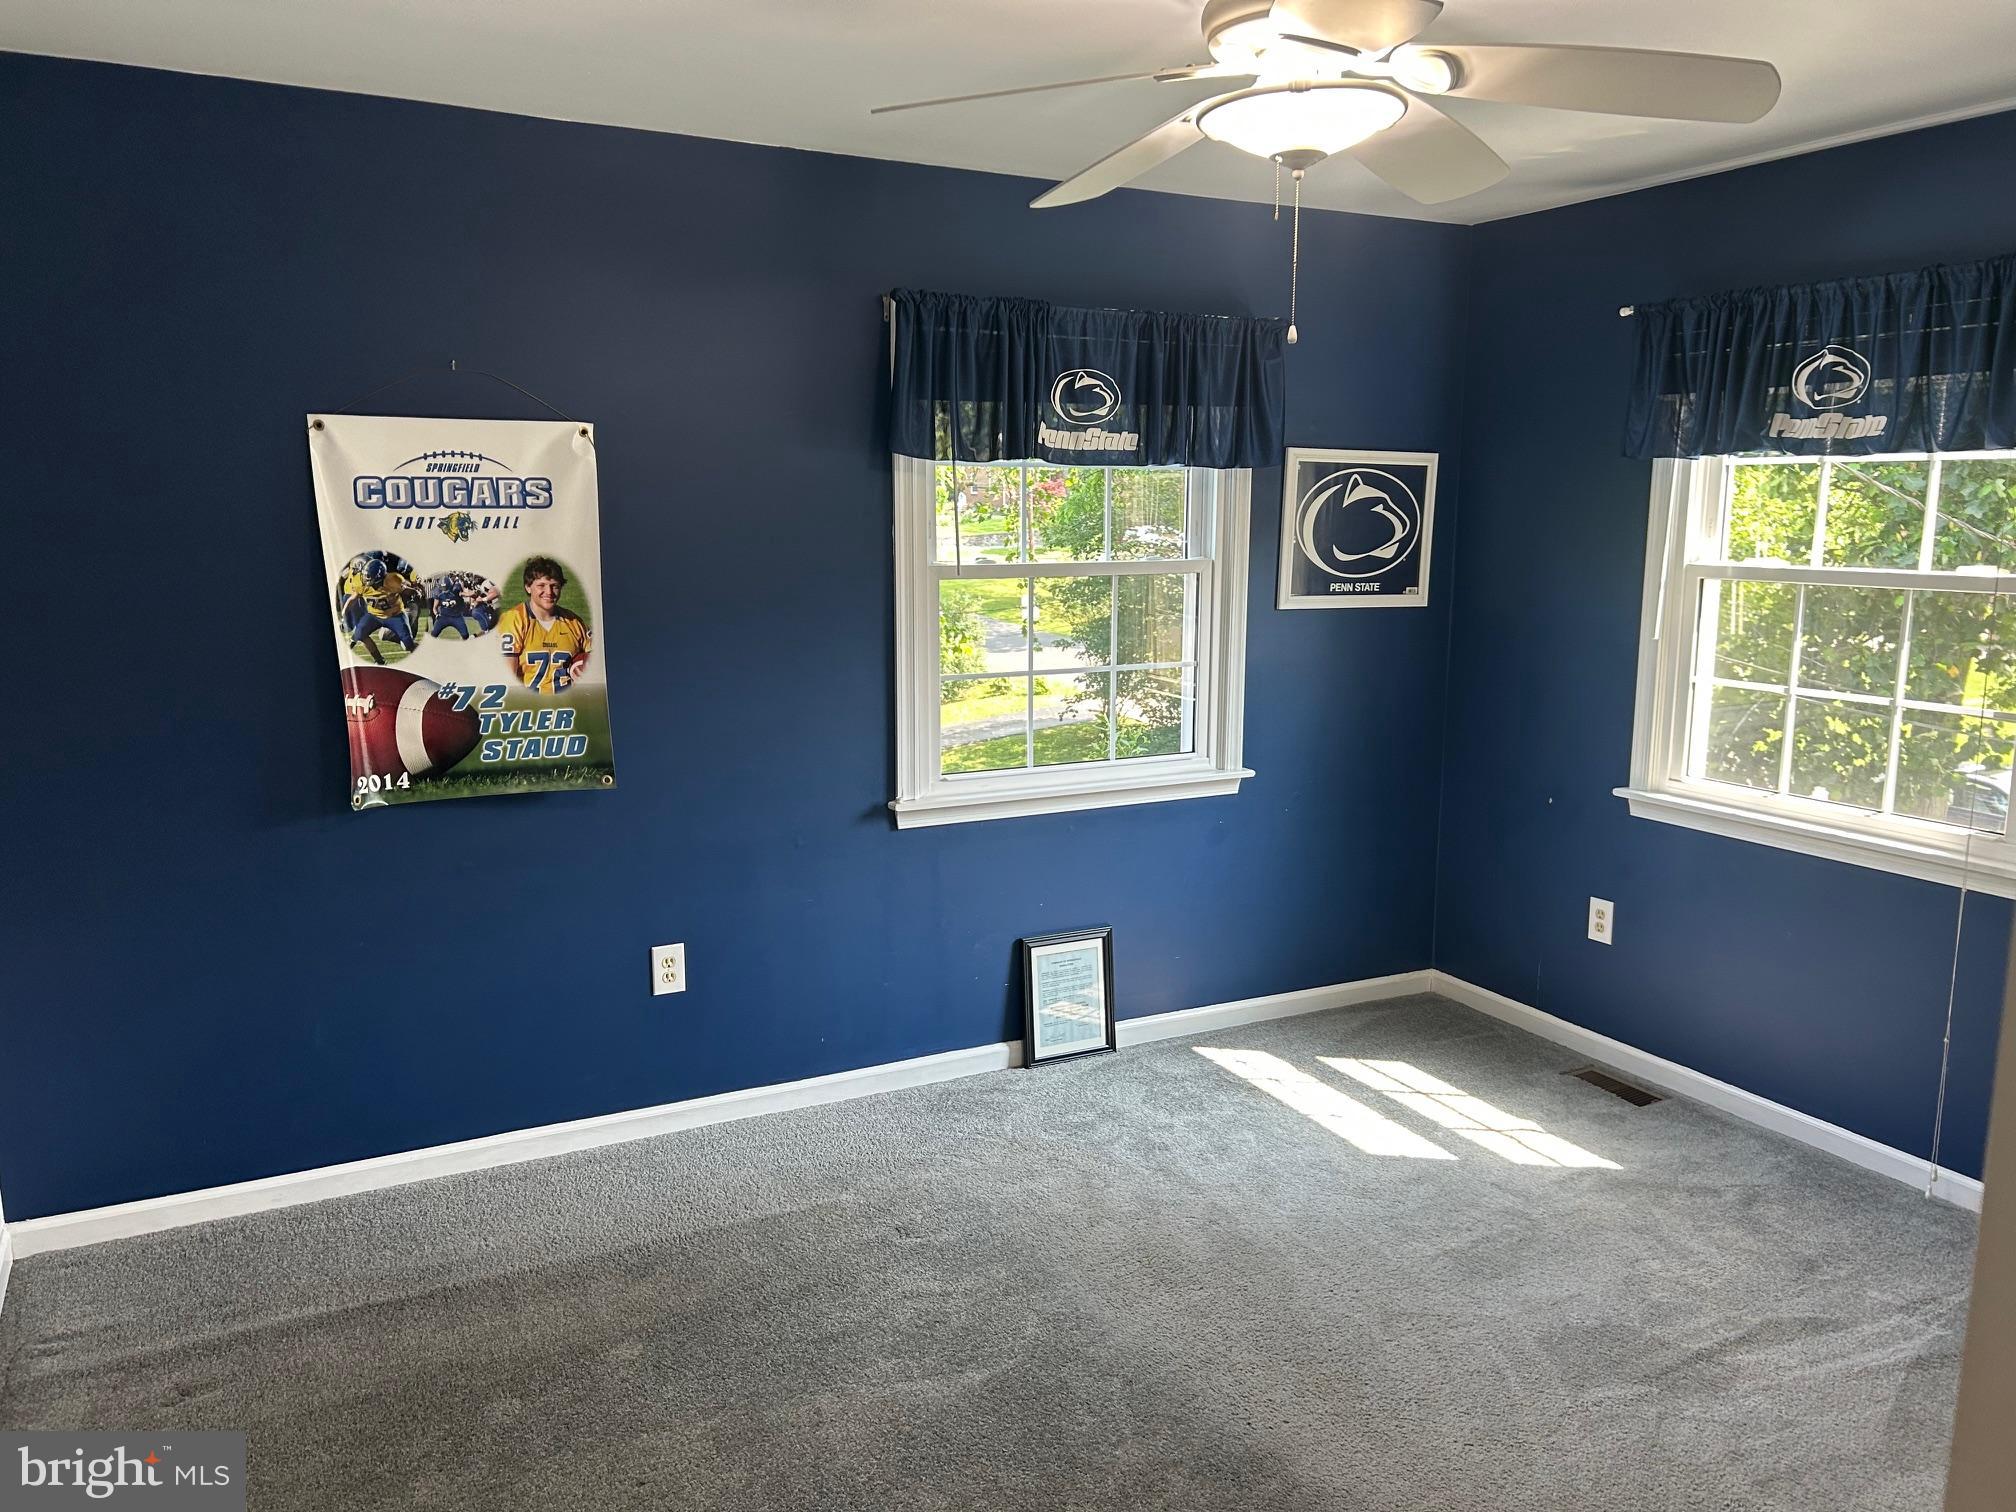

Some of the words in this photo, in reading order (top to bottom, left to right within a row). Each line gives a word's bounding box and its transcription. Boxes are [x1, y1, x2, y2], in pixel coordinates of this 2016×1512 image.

[426, 463, 480, 473] SPRINGFIELD
[353, 475, 554, 509] COUGARS
[394, 516, 435, 529] FOOT
[482, 516, 520, 529] BALL
[1329, 582, 1353, 592] PENN
[1354, 582, 1381, 592] STATE
[479, 709, 576, 735] TYLER
[480, 735, 588, 762] STAUD
[357, 771, 411, 795] 2014
